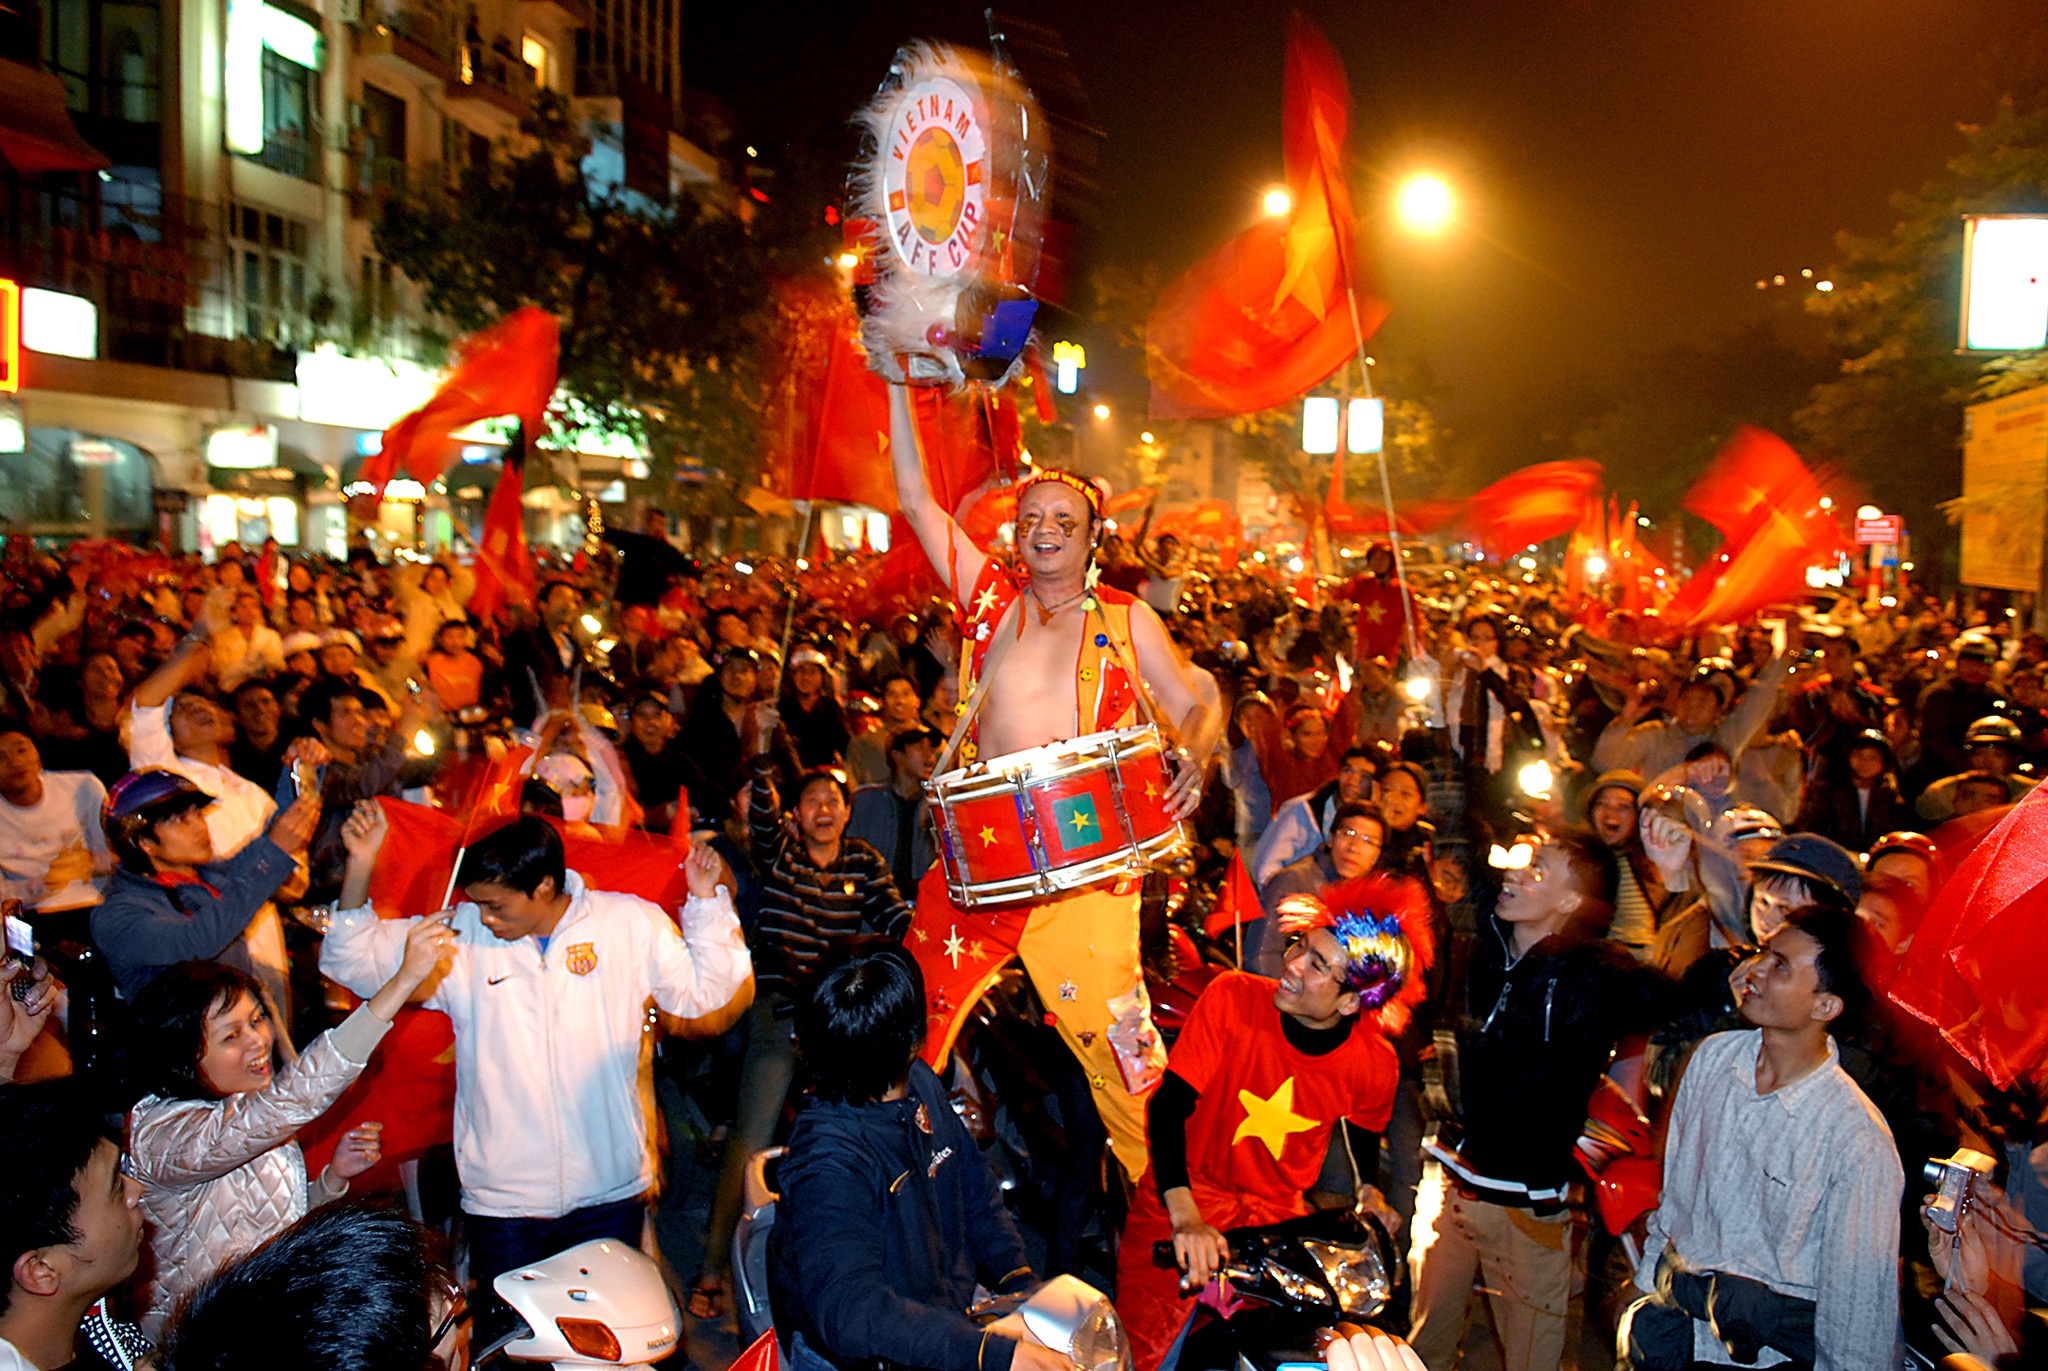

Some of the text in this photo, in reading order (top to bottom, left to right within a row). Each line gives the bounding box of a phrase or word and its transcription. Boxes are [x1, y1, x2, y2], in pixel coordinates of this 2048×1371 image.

[893, 94, 970, 161] VIETNAM
[897, 200, 978, 276] AFF CUP
